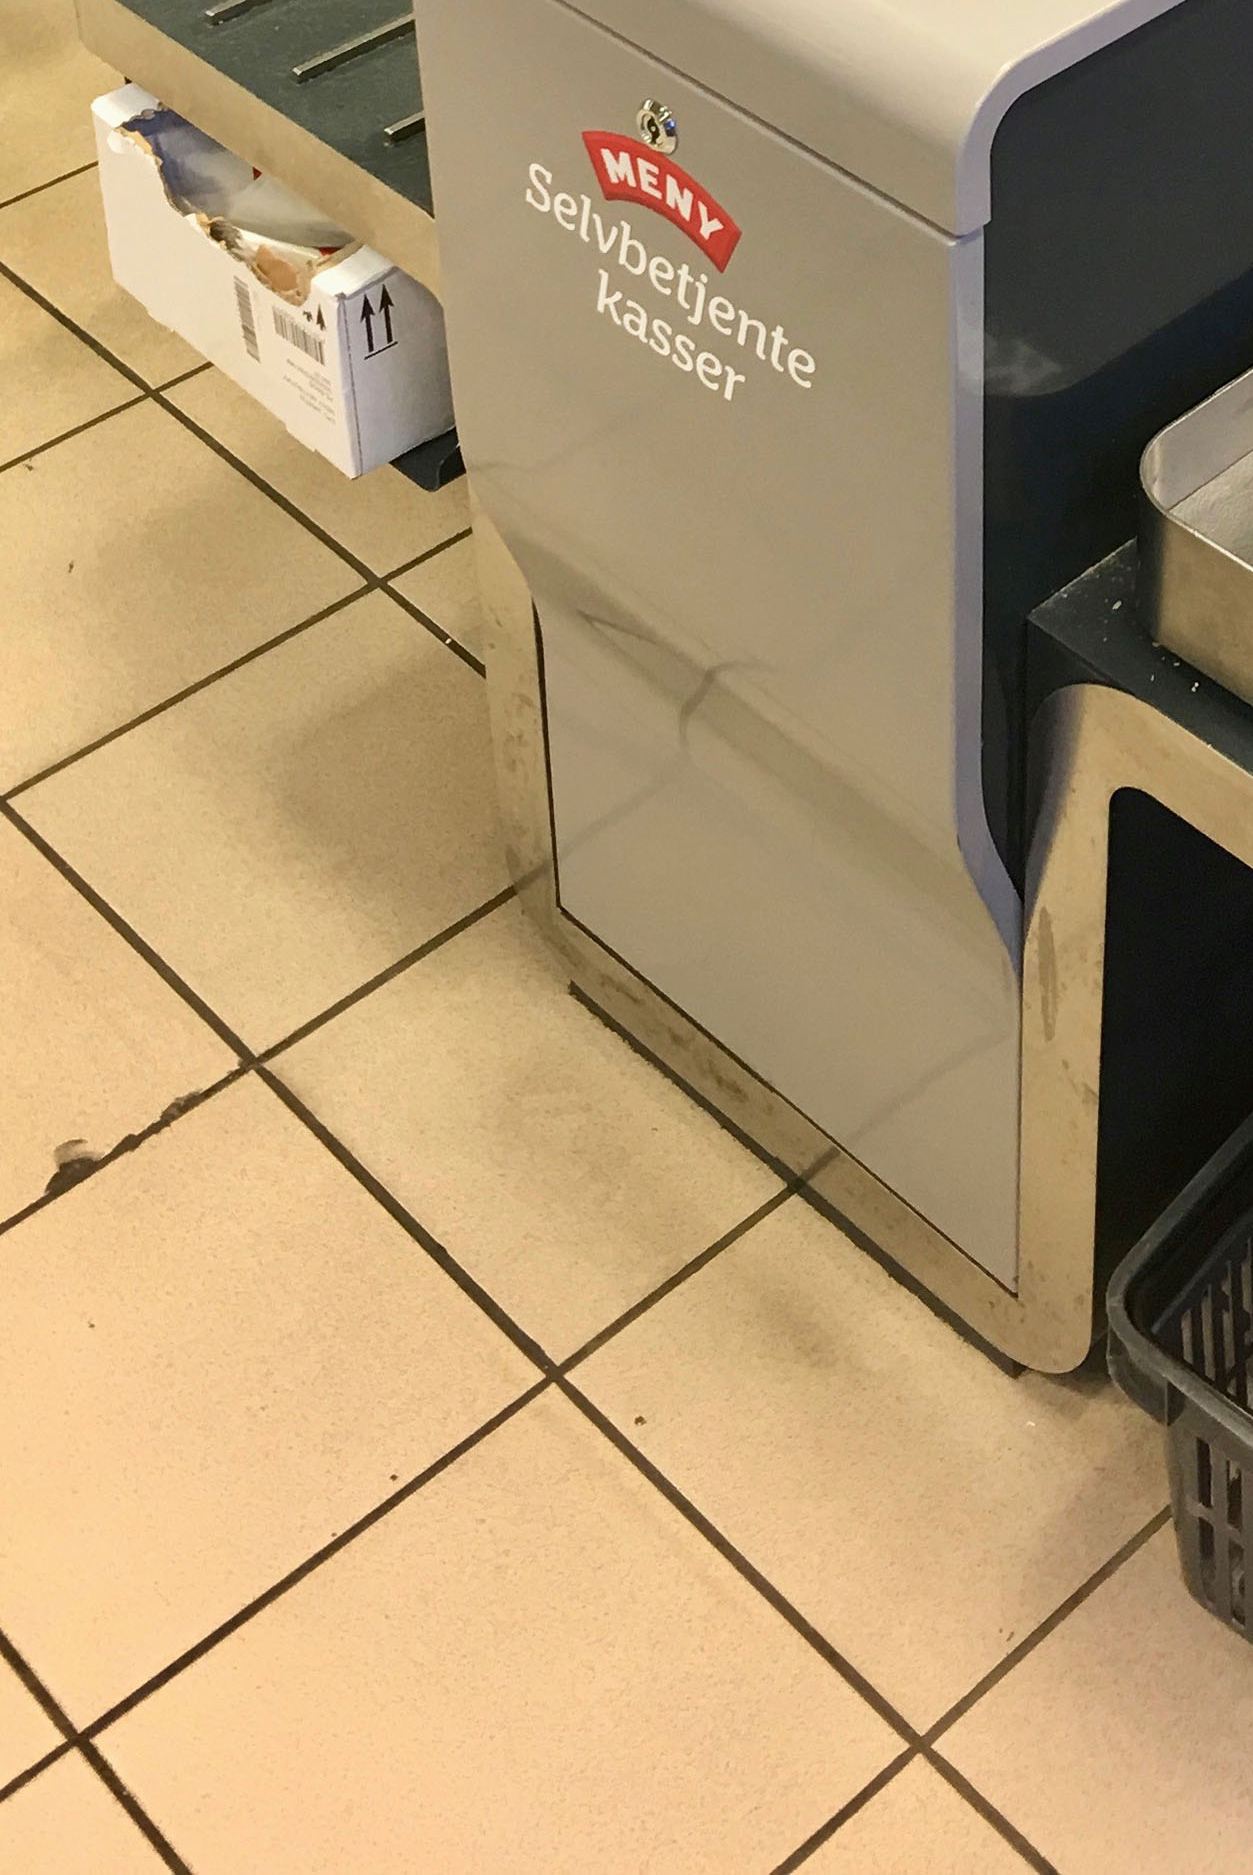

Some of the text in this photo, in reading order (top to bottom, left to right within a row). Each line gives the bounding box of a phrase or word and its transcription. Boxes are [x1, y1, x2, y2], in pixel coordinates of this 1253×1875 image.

[600, 148, 723, 241] MENY
[526, 162, 816, 389] Selvbetjente
[597, 269, 746, 401] kasser
